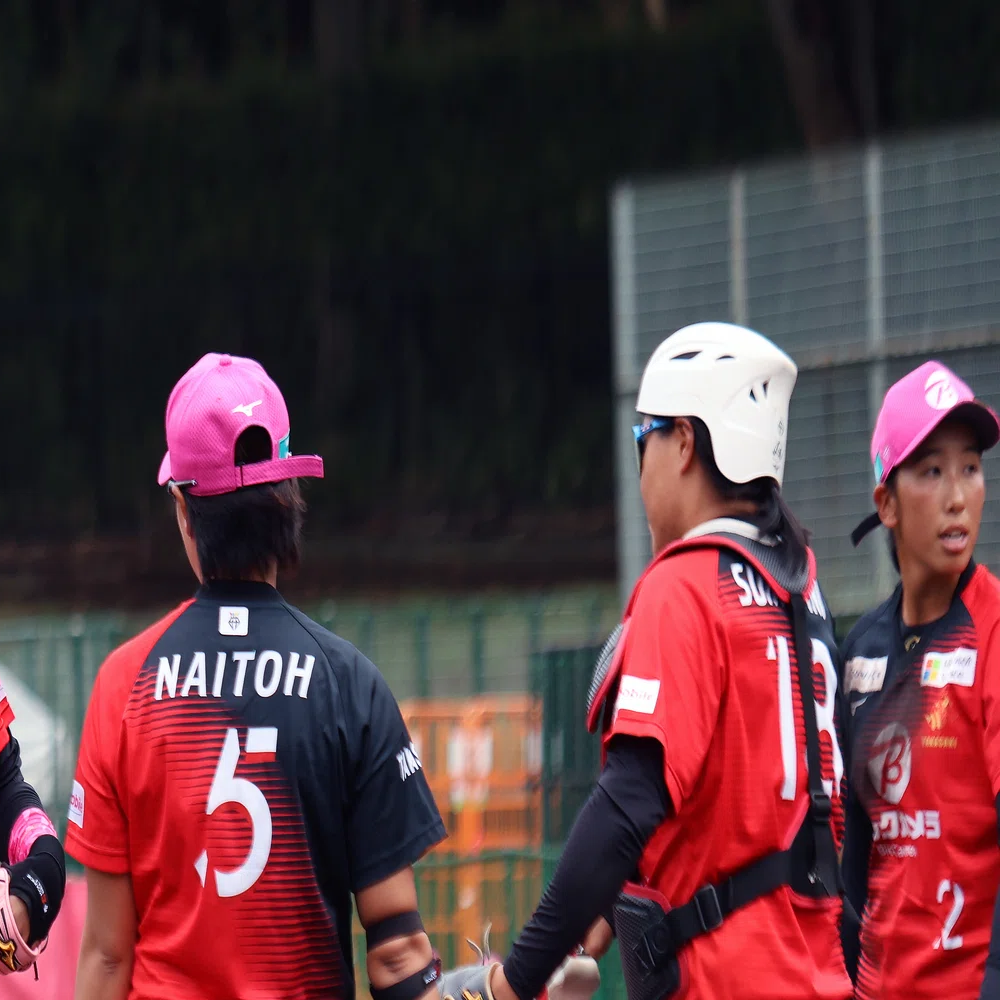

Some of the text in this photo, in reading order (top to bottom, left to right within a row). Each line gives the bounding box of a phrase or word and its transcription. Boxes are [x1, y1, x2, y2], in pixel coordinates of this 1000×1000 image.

[154, 650, 316, 700] NAITOH
[194, 727, 279, 898] 5
[932, 879, 965, 950] 2
